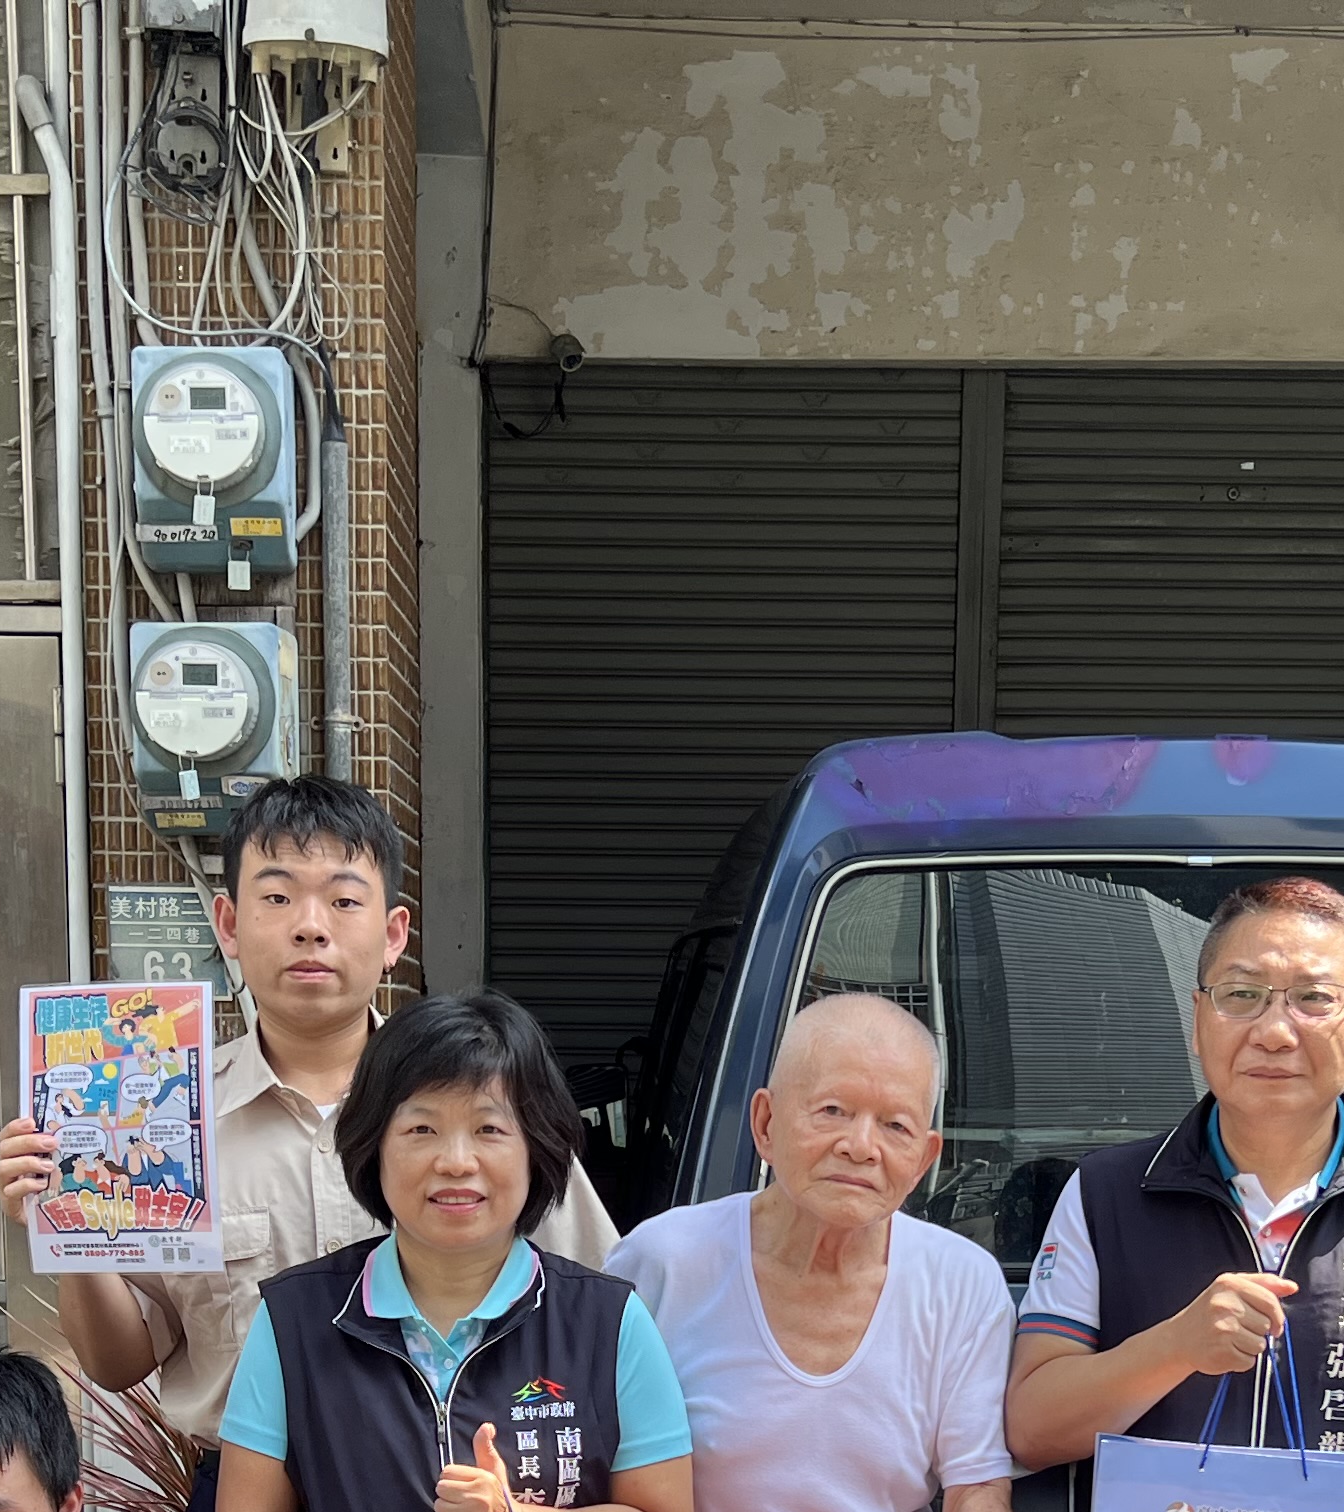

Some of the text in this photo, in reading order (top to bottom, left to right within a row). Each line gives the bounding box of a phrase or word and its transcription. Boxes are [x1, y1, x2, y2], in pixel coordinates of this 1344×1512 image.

[110, 896, 206, 919] 美村路二
[128, 927, 200, 944] 一二四巷
[110, 988, 153, 1018] GO!
[511, 1401, 576, 1421] 臺中市政府
